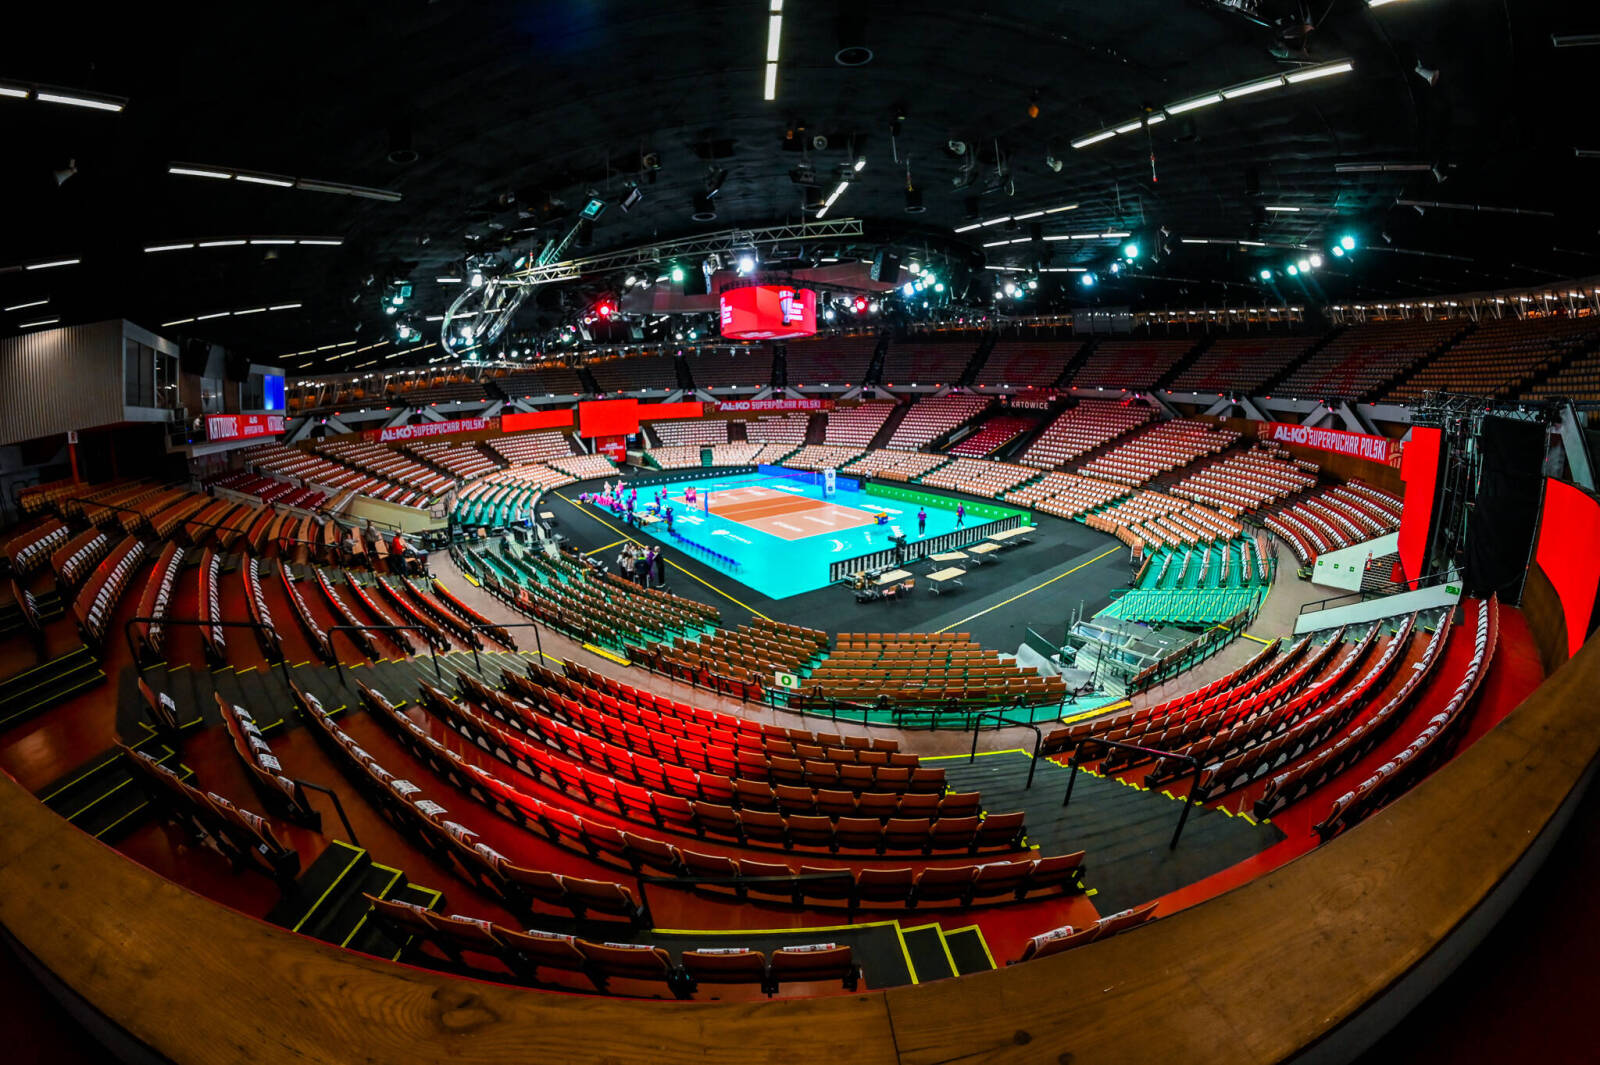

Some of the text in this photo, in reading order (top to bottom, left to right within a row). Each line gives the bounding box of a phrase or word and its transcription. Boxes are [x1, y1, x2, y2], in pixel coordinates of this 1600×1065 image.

[720, 400, 821, 411] AL-KO SUPERPUCHAR POLSKI
[1011, 401, 1049, 410] KATOWICE
[380, 418, 485, 441] AL-KO SUPERPUCHAR POLSKI
[1274, 426, 1387, 461] AL-KO SUPERPUCHAR POLSKI
